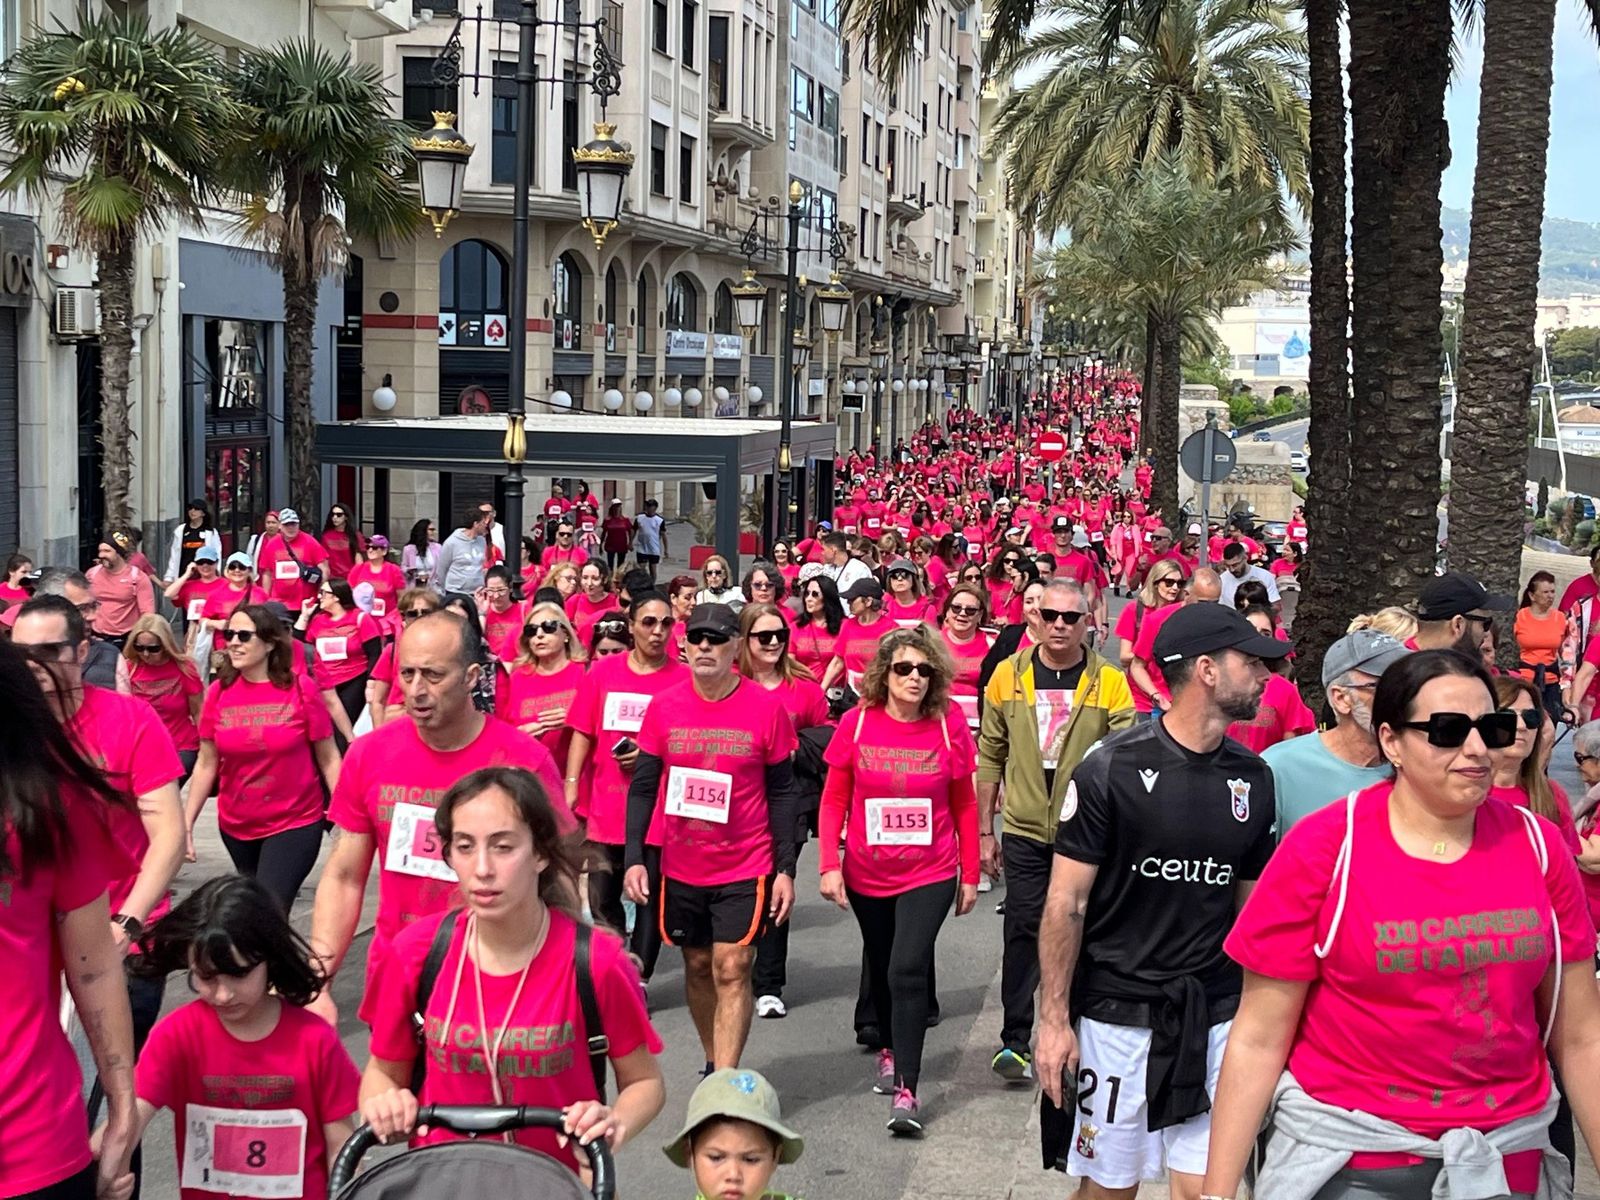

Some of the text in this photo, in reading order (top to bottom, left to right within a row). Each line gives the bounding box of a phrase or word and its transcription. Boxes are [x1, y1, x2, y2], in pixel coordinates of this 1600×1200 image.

[686, 785, 726, 805] 1154
[884, 814, 928, 829] 1153
[1140, 857, 1233, 885] ceuta
[1373, 907, 1542, 947] XXI CARRERA
[1376, 948, 1418, 973] DE
[1463, 934, 1549, 971] MUJER
[454, 1021, 576, 1050] CARRERA
[1077, 1067, 1122, 1125] 21
[246, 1140, 266, 1168] 8
